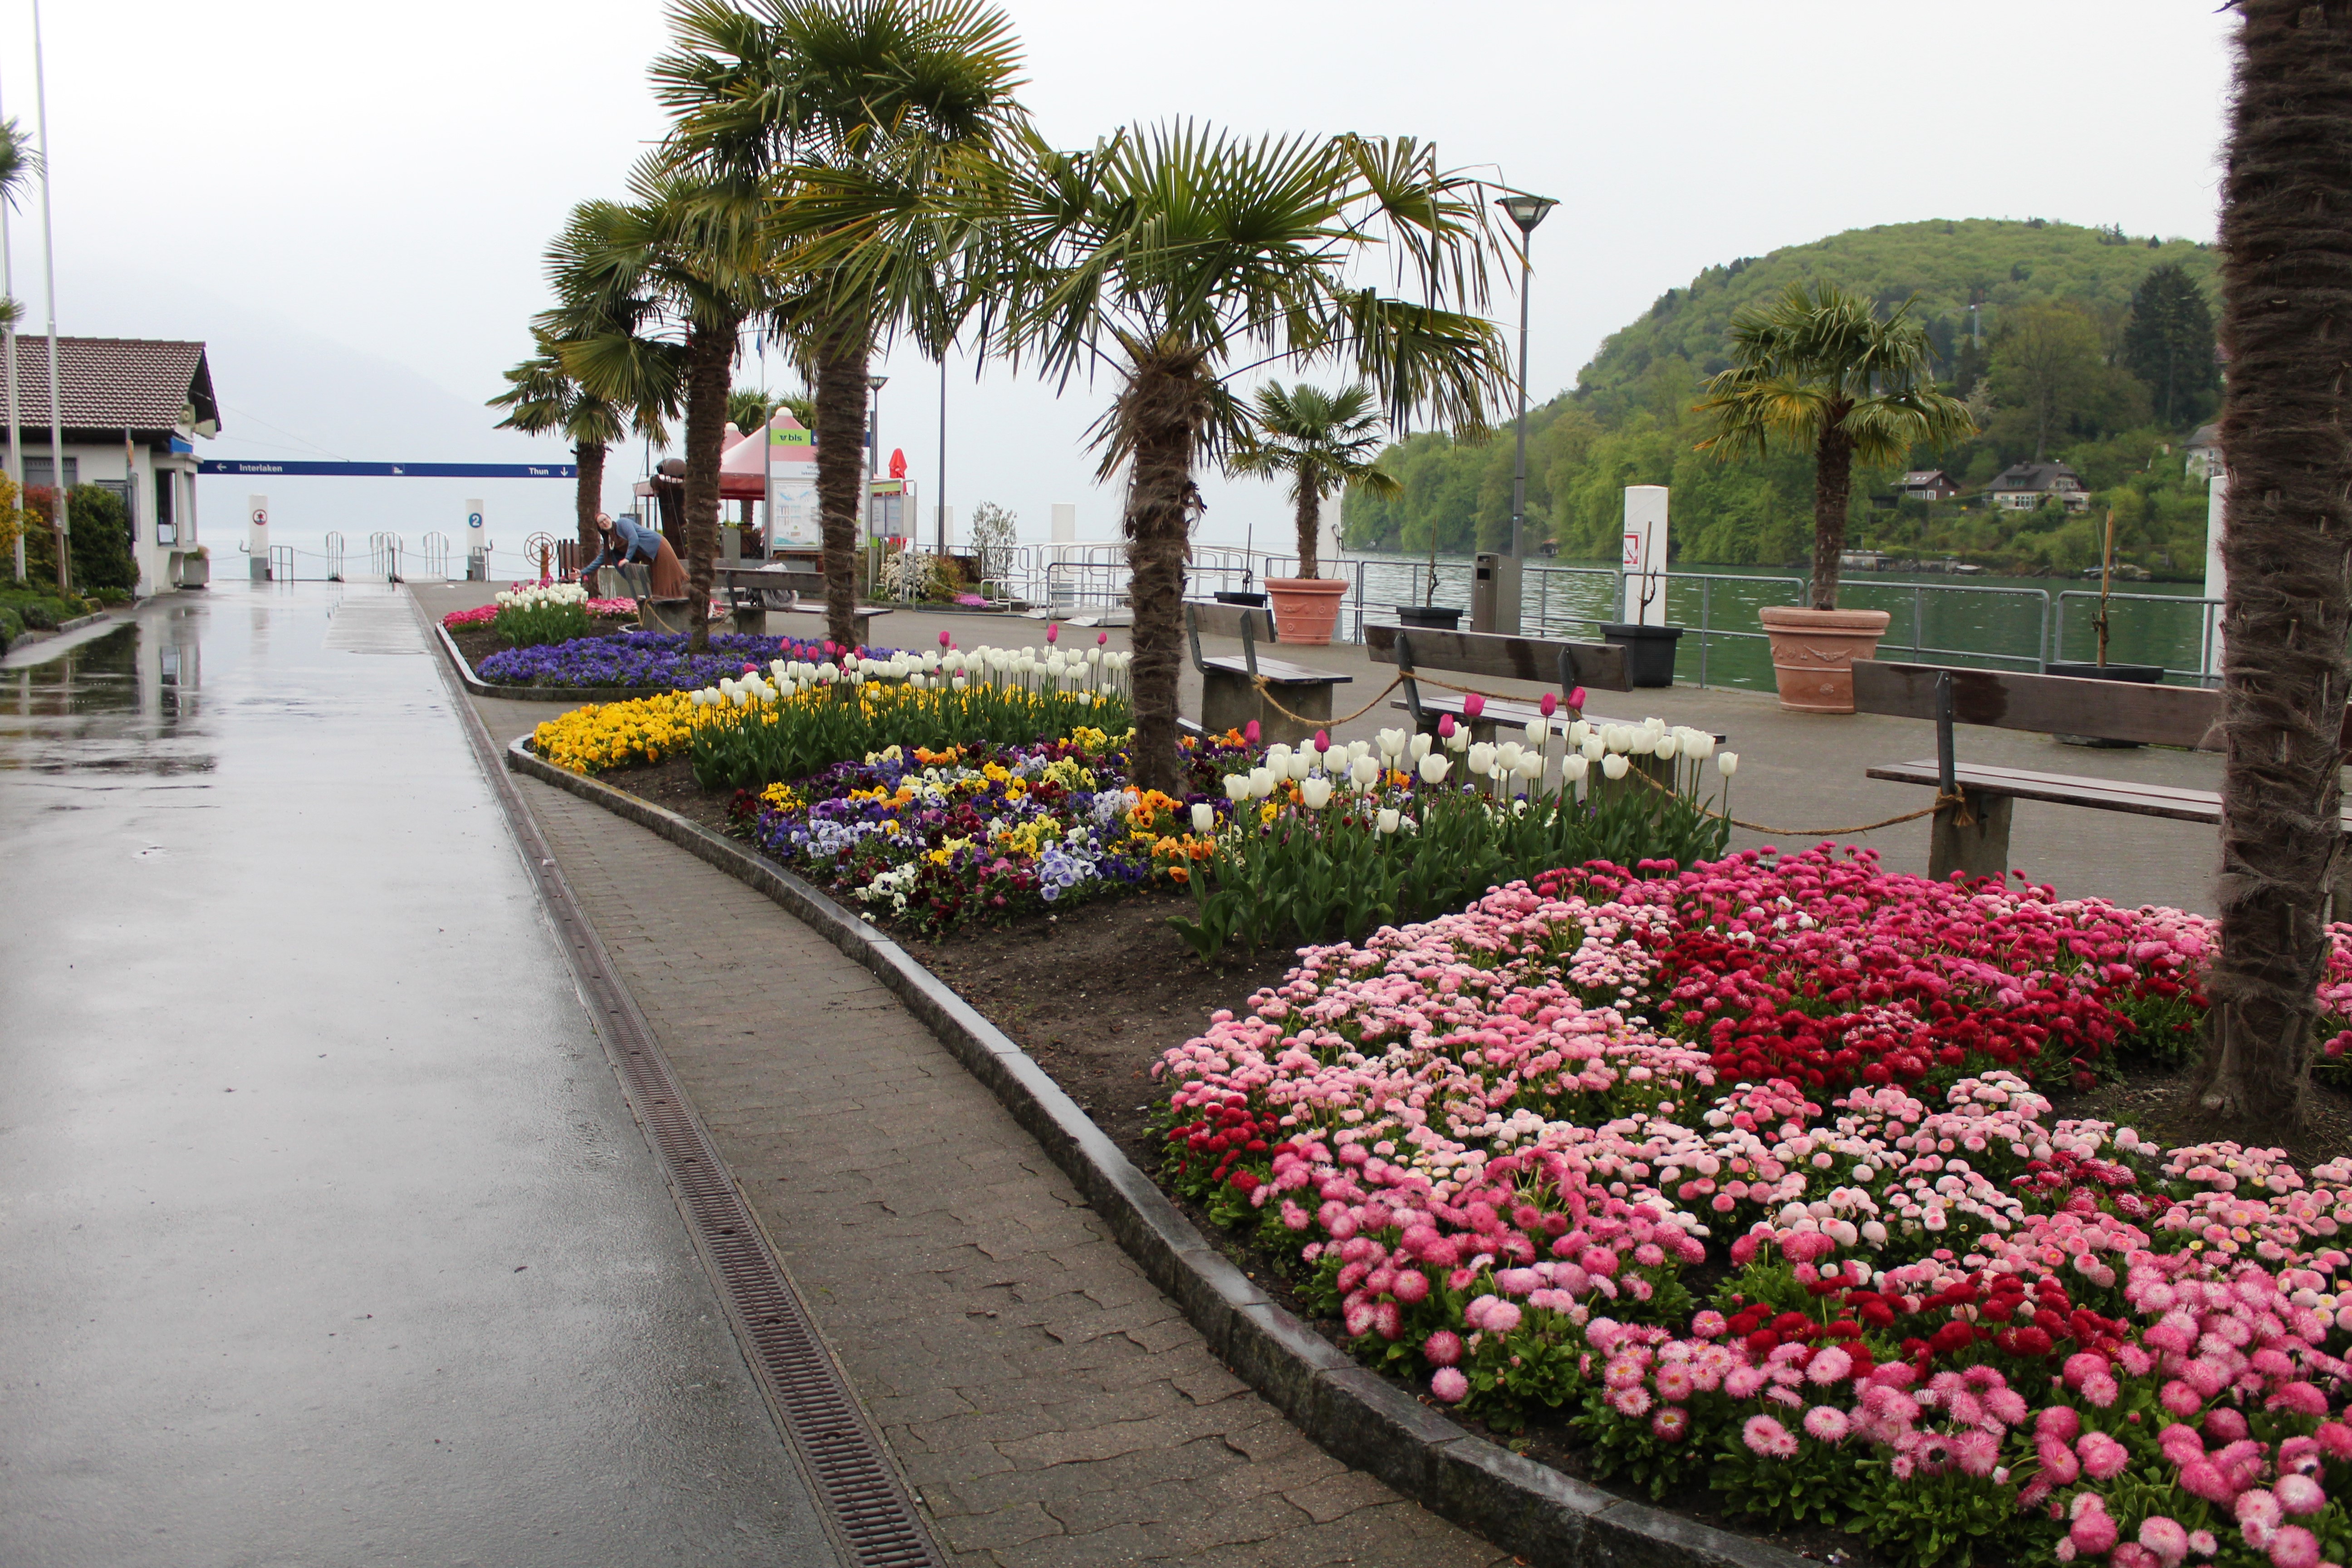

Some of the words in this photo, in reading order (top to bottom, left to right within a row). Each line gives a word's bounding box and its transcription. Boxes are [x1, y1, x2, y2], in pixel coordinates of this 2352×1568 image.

[239, 463, 283, 472] Interlaken
[528, 467, 549, 475] Thun
[472, 514, 480, 526] 2
